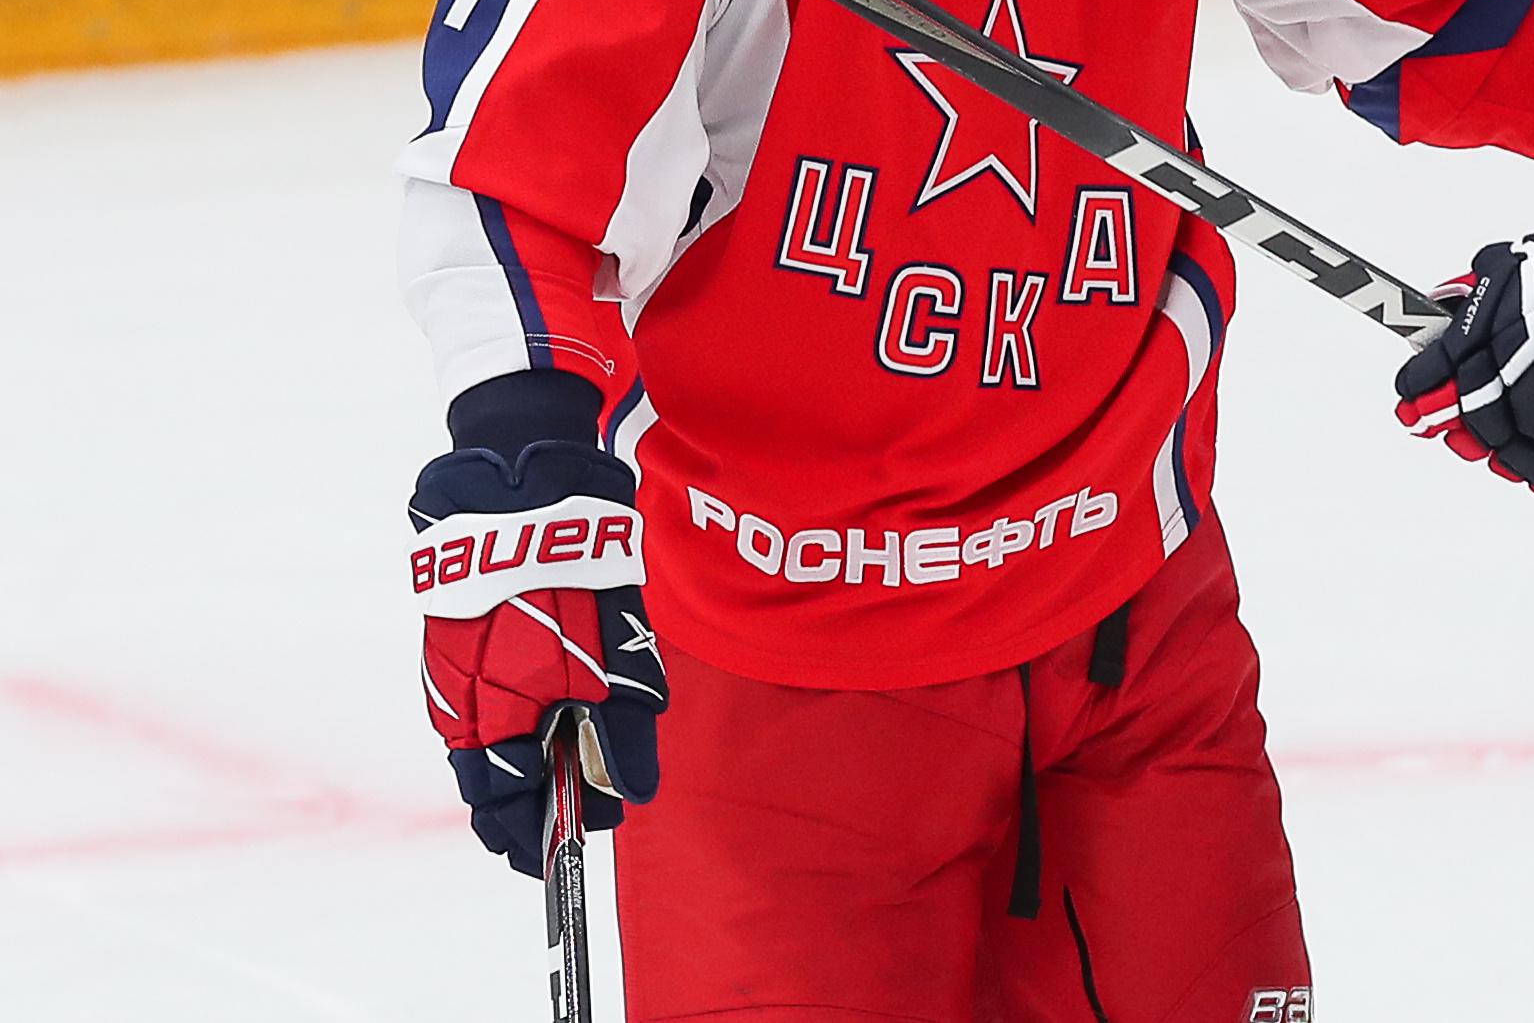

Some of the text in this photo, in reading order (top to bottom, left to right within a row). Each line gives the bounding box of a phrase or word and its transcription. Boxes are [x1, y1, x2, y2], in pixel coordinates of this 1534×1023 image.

[1105, 130, 1453, 348] CCM
[1462, 276, 1490, 336] COVERT
[410, 515, 634, 595] BAUER
[687, 485, 1119, 588] РОСНЕФТЬ
